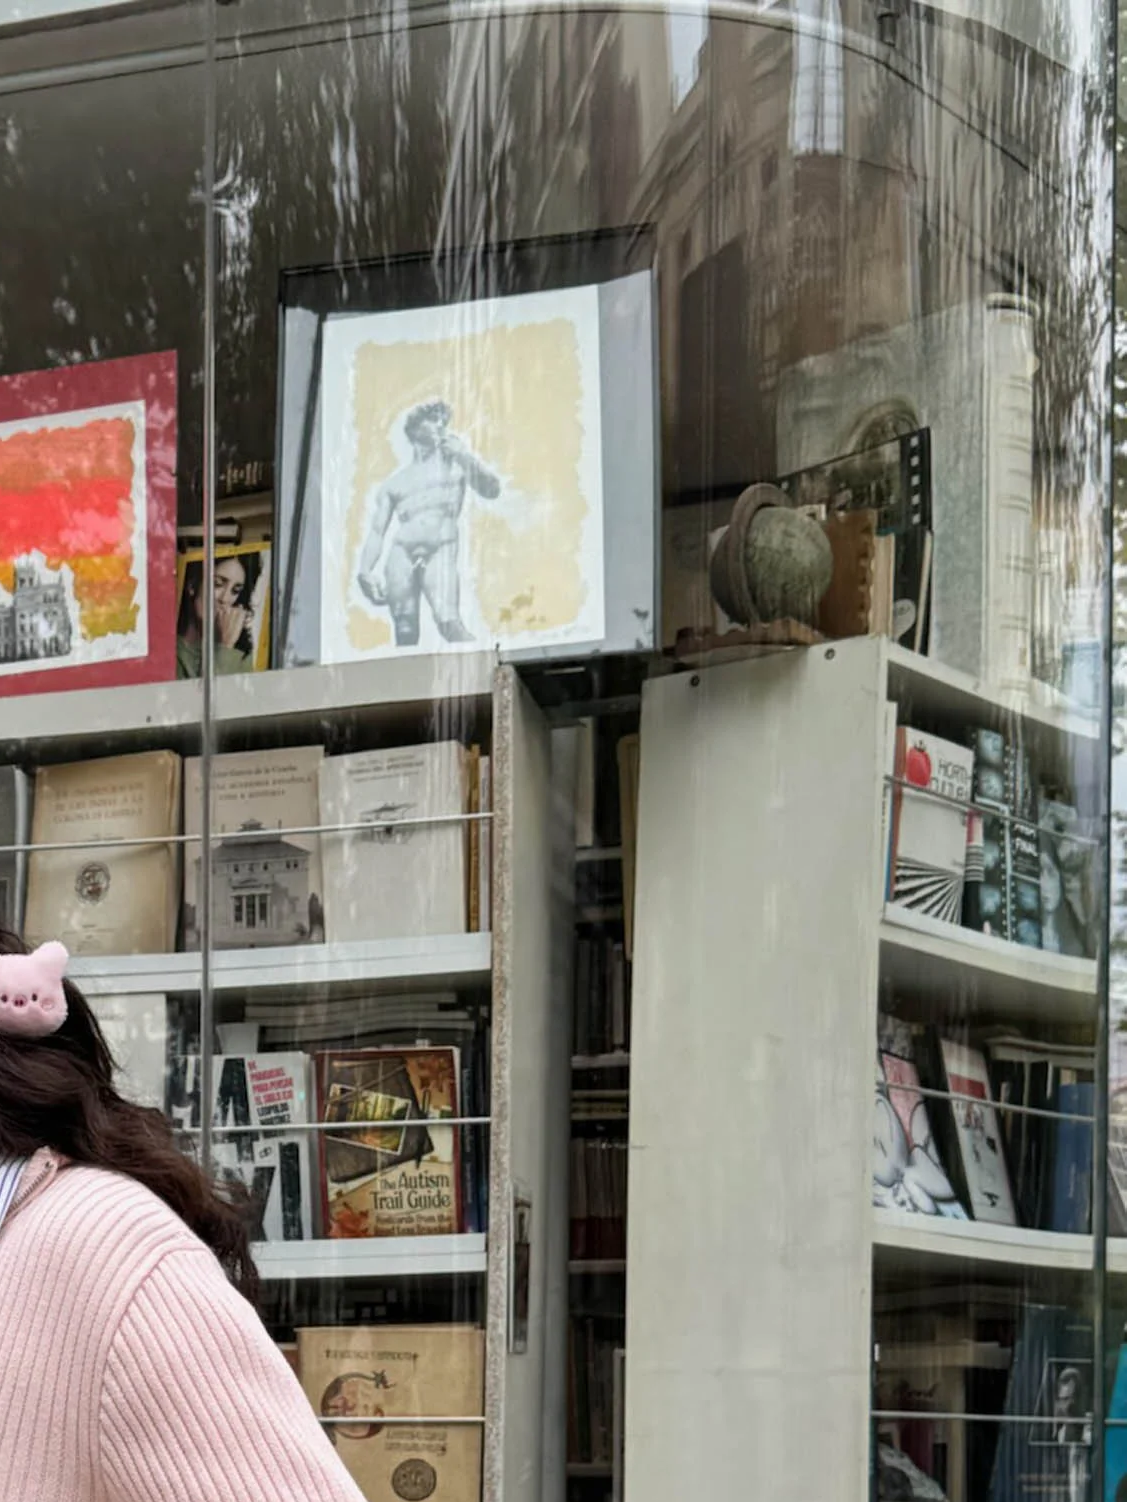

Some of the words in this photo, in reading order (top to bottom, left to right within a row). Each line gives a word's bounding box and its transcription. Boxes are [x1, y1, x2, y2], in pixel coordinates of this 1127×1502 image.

[398, 1170, 450, 1189] Autism
[370, 1190, 404, 1210] Trail
[407, 1189, 451, 1209] Guide
